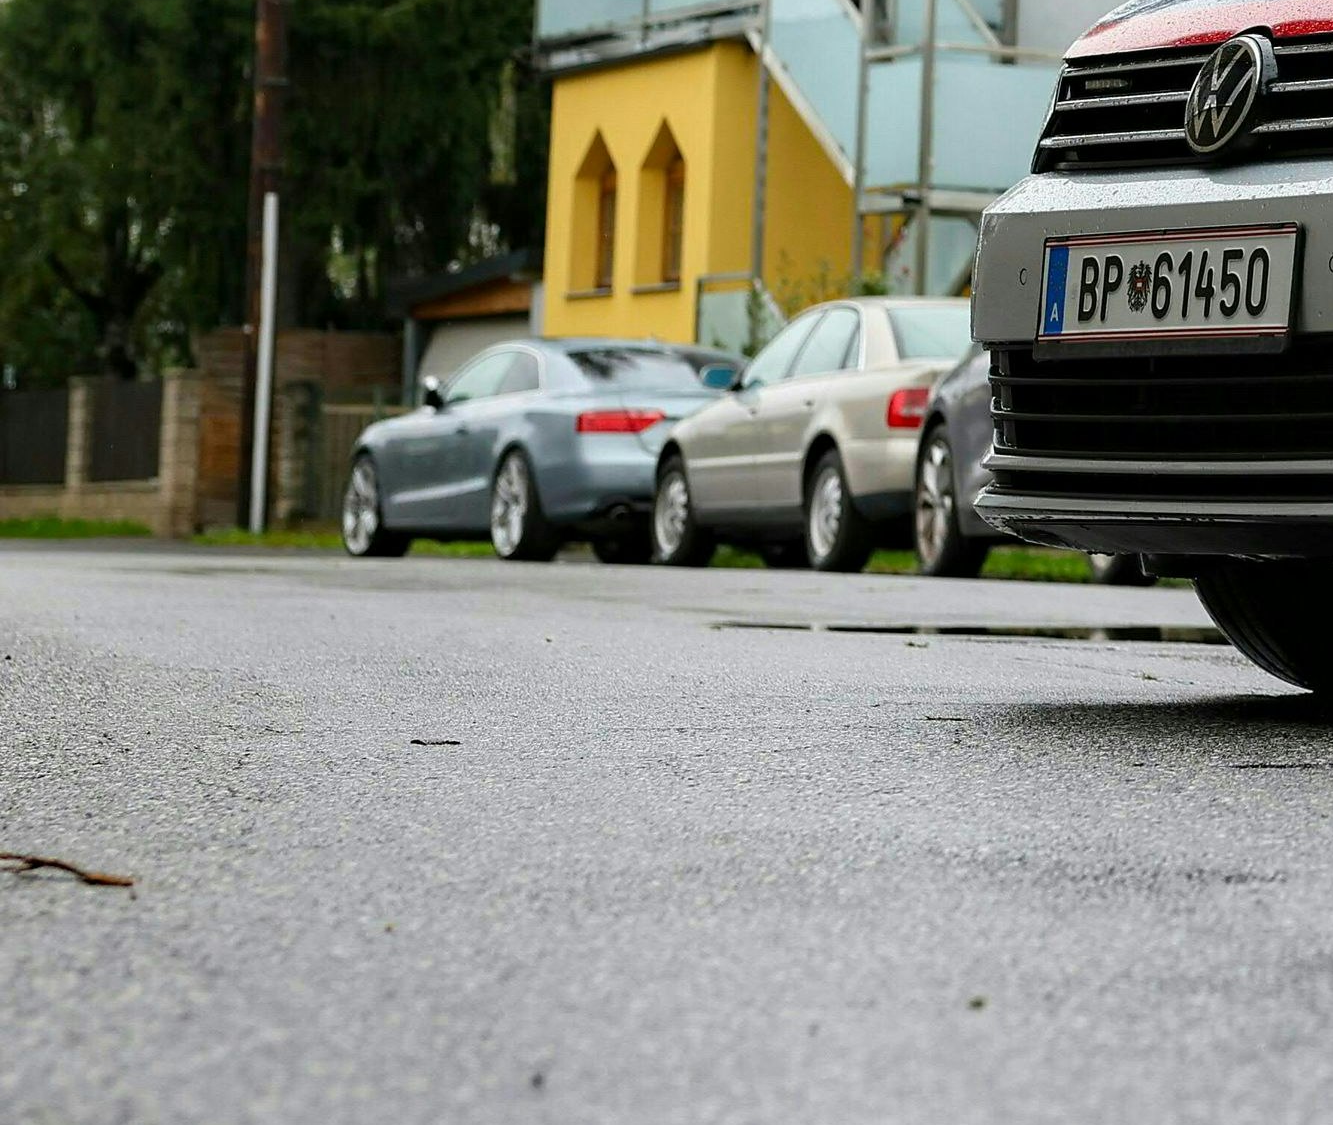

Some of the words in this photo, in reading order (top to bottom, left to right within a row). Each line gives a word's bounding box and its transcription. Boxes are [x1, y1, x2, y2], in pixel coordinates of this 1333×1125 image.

[1186, 38, 1260, 146] VW
[1049, 301, 1060, 323] A
[1077, 254, 1125, 323] BP
[1150, 246, 1271, 321] 61450
